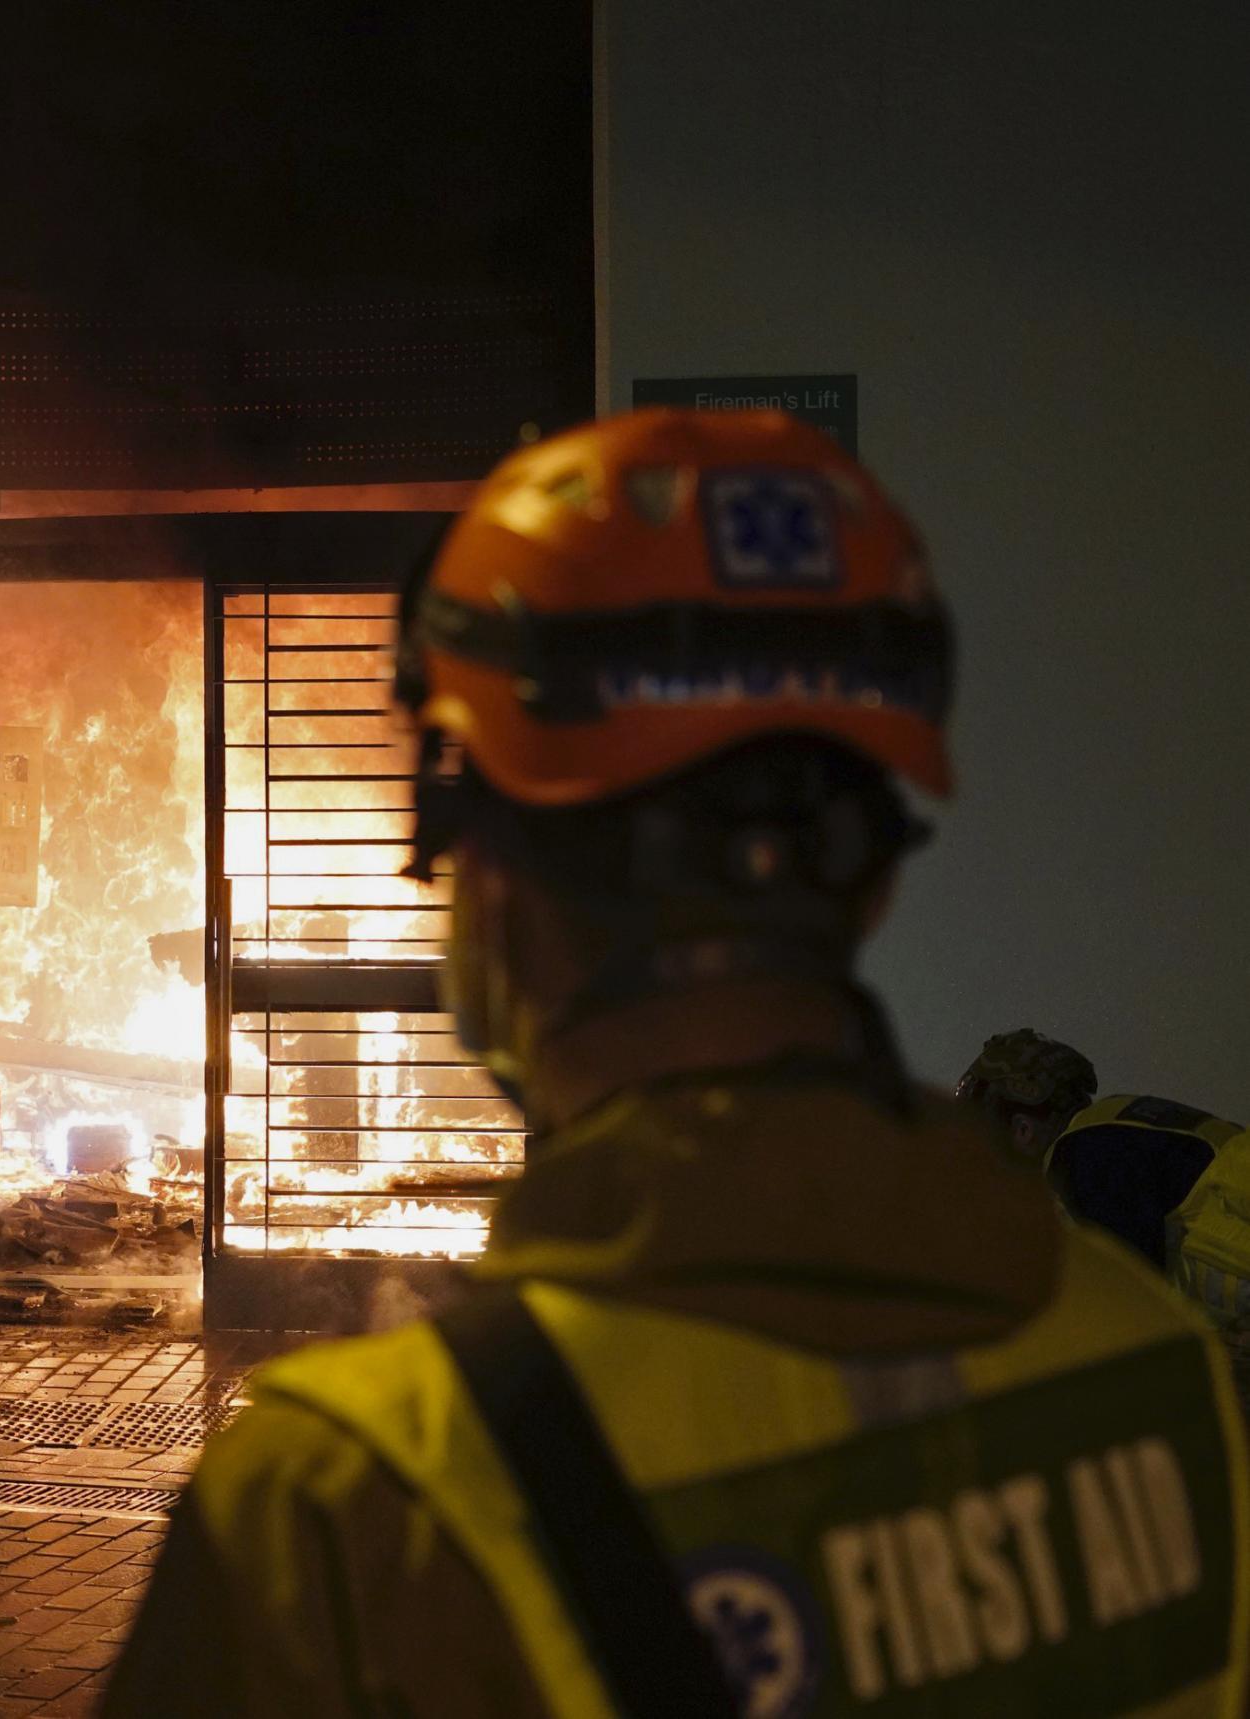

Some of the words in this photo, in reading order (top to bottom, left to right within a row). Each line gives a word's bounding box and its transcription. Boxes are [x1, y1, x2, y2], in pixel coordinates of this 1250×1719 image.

[695, 391, 799, 411] Fireman's
[805, 389, 841, 409] Lift
[821, 1471, 1068, 1702] FIRST
[1064, 1435, 1202, 1629] AID
